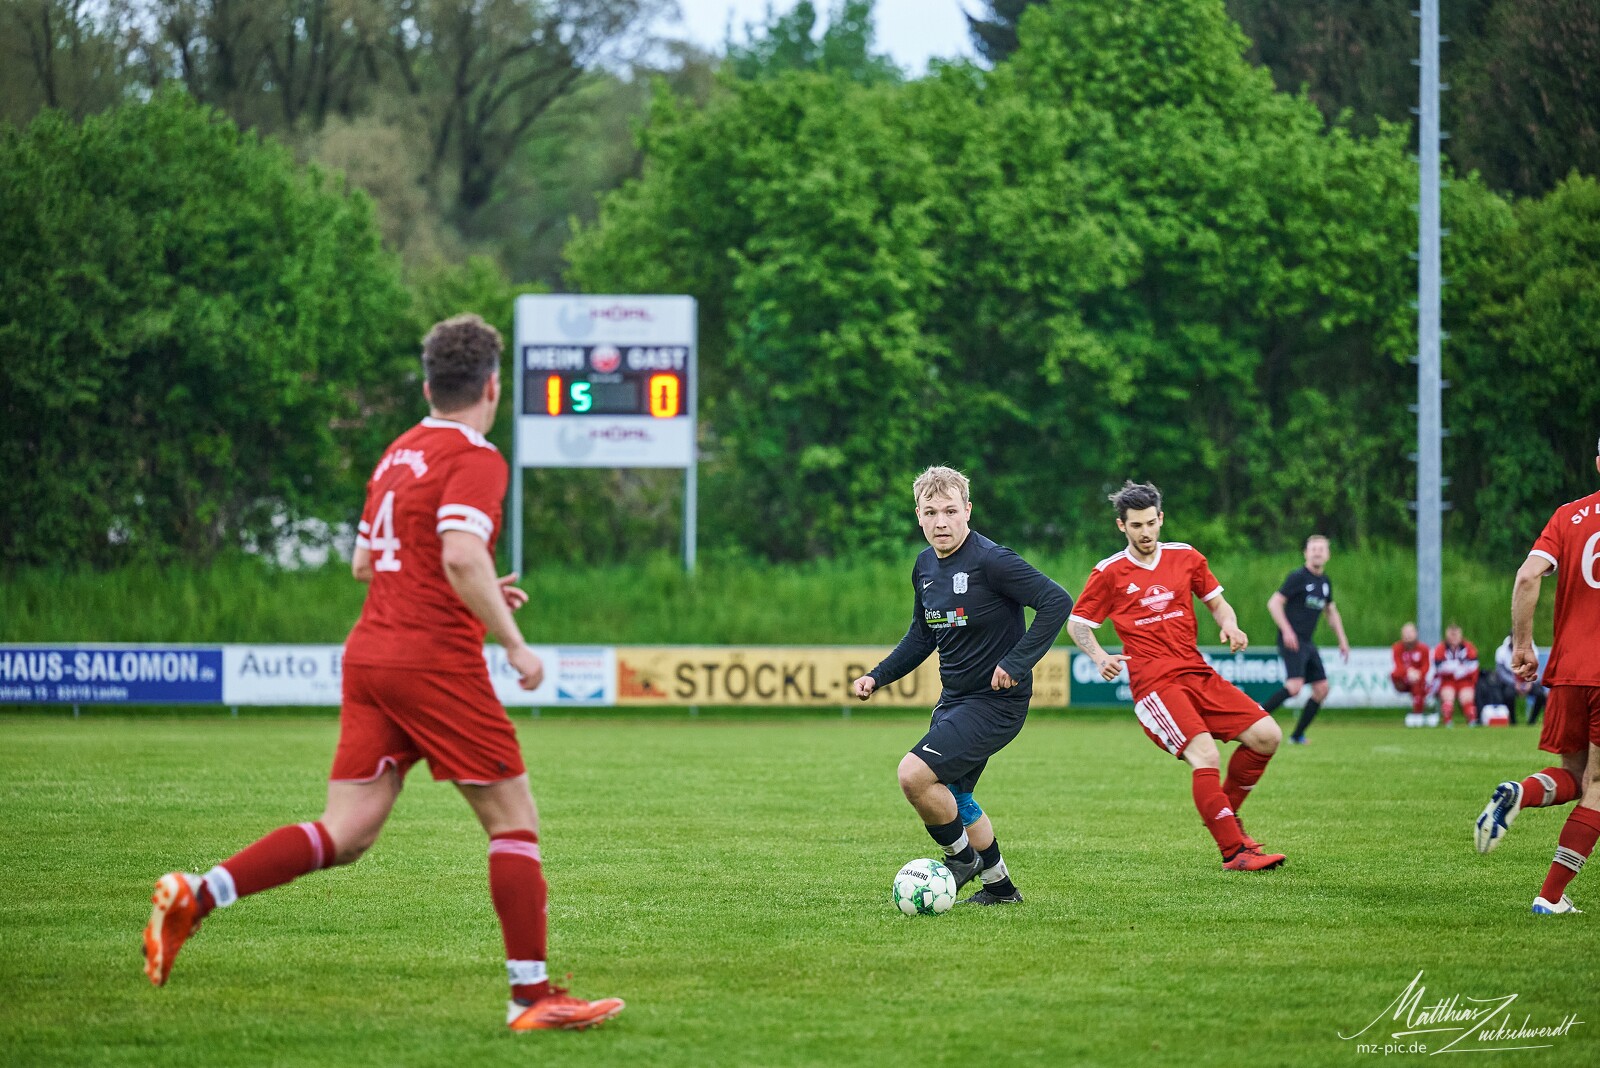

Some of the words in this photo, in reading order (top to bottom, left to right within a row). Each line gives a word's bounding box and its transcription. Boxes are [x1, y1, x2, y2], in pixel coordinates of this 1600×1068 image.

[526, 349, 585, 370] HEIM
[627, 349, 686, 370] GAST
[547, 375, 562, 416] 1
[649, 372, 681, 418] 0
[1571, 506, 1590, 525] SV
[370, 490, 402, 572] 4
[924, 608, 941, 620] Gries
[238, 651, 319, 678] Auto
